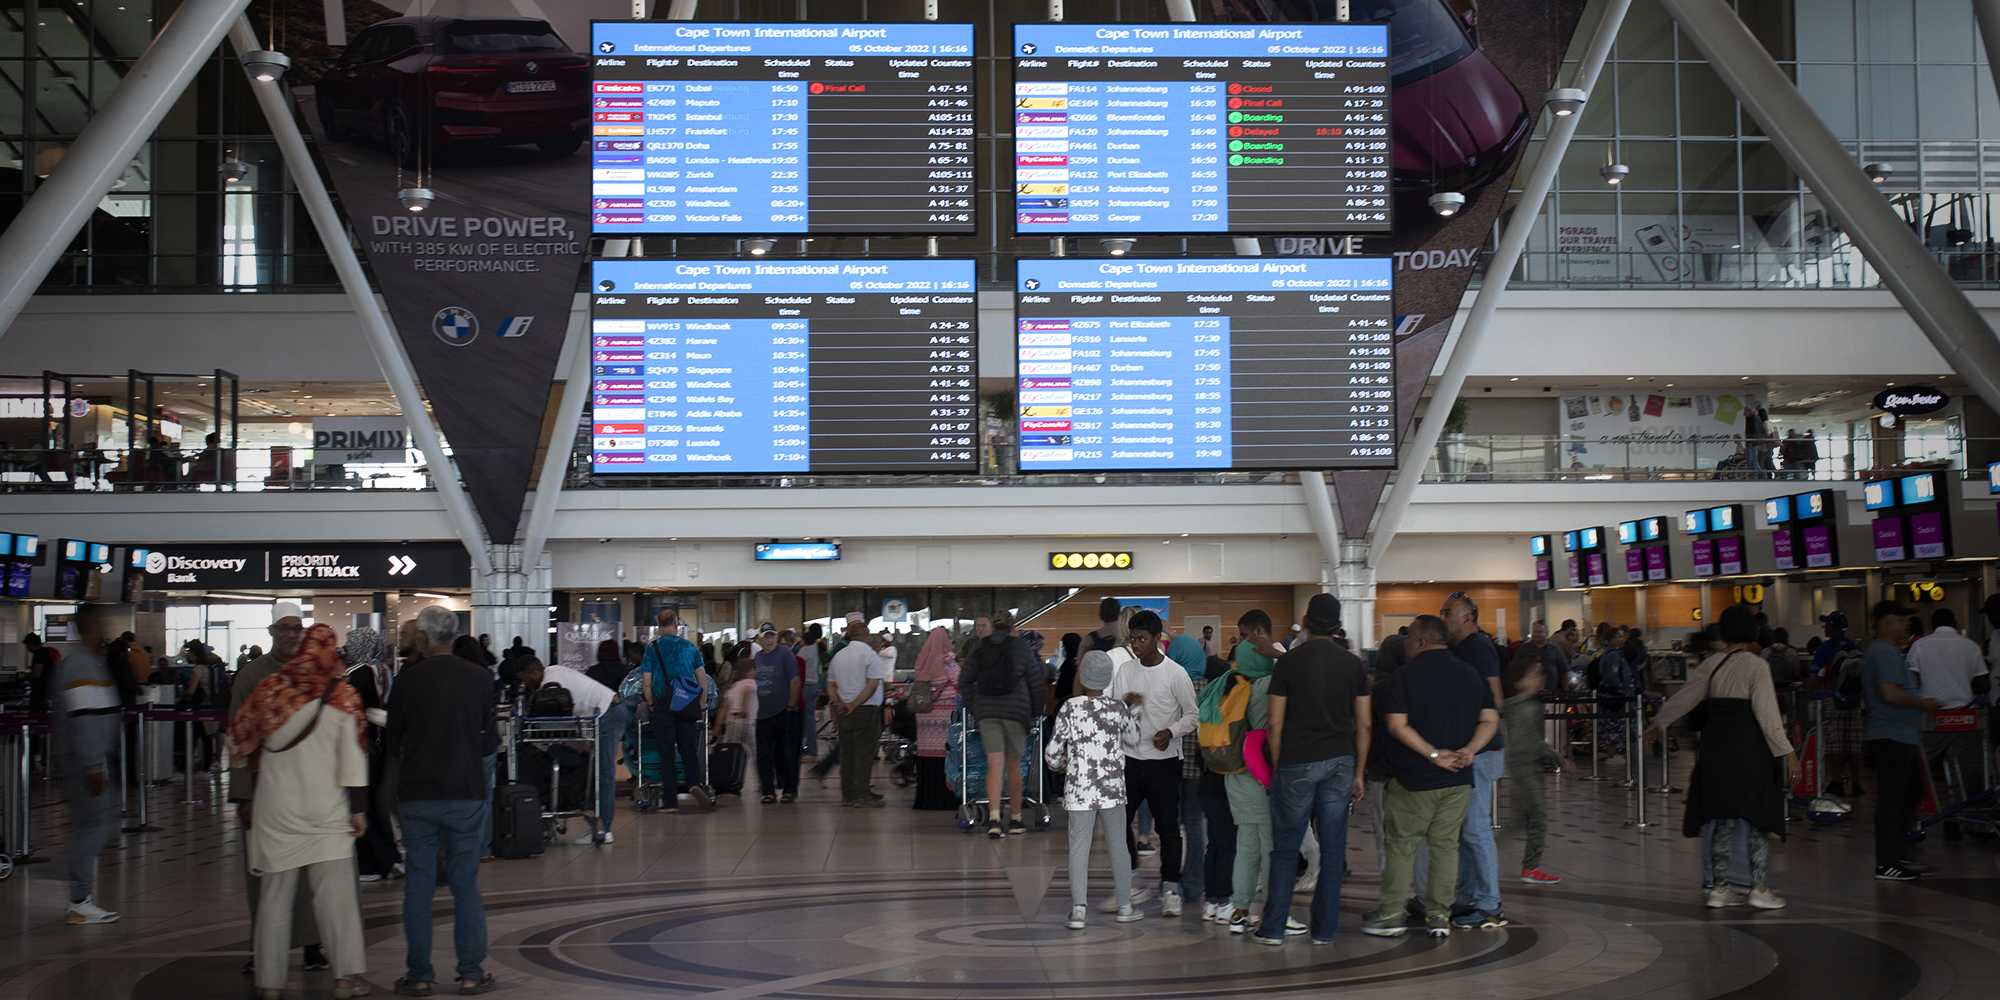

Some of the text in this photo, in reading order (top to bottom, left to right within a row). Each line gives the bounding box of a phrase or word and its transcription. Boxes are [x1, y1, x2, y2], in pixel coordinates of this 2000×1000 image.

[676, 28, 886, 39] Cape Town International Airport
[1096, 29, 1303, 40] Cape Town International Airport
[698, 44, 751, 53] Departures
[1102, 46, 1154, 54] Departures
[647, 59, 679, 67] Flight#
[889, 59, 927, 68] Updated
[824, 84, 865, 92] Final Call
[1106, 86, 1168, 94] Johannesburg
[1243, 85, 1273, 93] Closed
[686, 99, 720, 107] Maputo
[1243, 99, 1283, 107] Final Call
[1243, 113, 1283, 123] Boarding
[1244, 128, 1342, 136] Delayed 18:10
[1244, 142, 1284, 151] Boarding
[1244, 157, 1284, 166] Boarding
[1108, 214, 1141, 222] George
[372, 216, 575, 241] DRIVE POWER,
[1582, 236, 1618, 245] TRAVEL
[371, 241, 580, 255] WITH 385 KW OF ELECTRIC
[1279, 237, 1478, 271] DRIVE TODAY.
[414, 259, 540, 273] PERFORMANCE.
[676, 265, 888, 276] Cape Town International Airport
[1099, 263, 1307, 275] Cape Town International Airport
[698, 282, 752, 291] Departures
[1105, 281, 1158, 289] Departures
[1071, 295, 1103, 304] Flight#
[1310, 294, 1347, 302] Updated
[686, 367, 732, 375] Singapore
[717, 396, 735, 404] Bay
[315, 431, 385, 448] PRIMI
[1865, 475, 1934, 505] 100 101
[1810, 494, 1822, 513] 99
[167, 556, 247, 572] Discovery
[281, 554, 340, 567] PRIORITY
[281, 566, 360, 578] FAST TRACK
[167, 573, 197, 583] Bank
